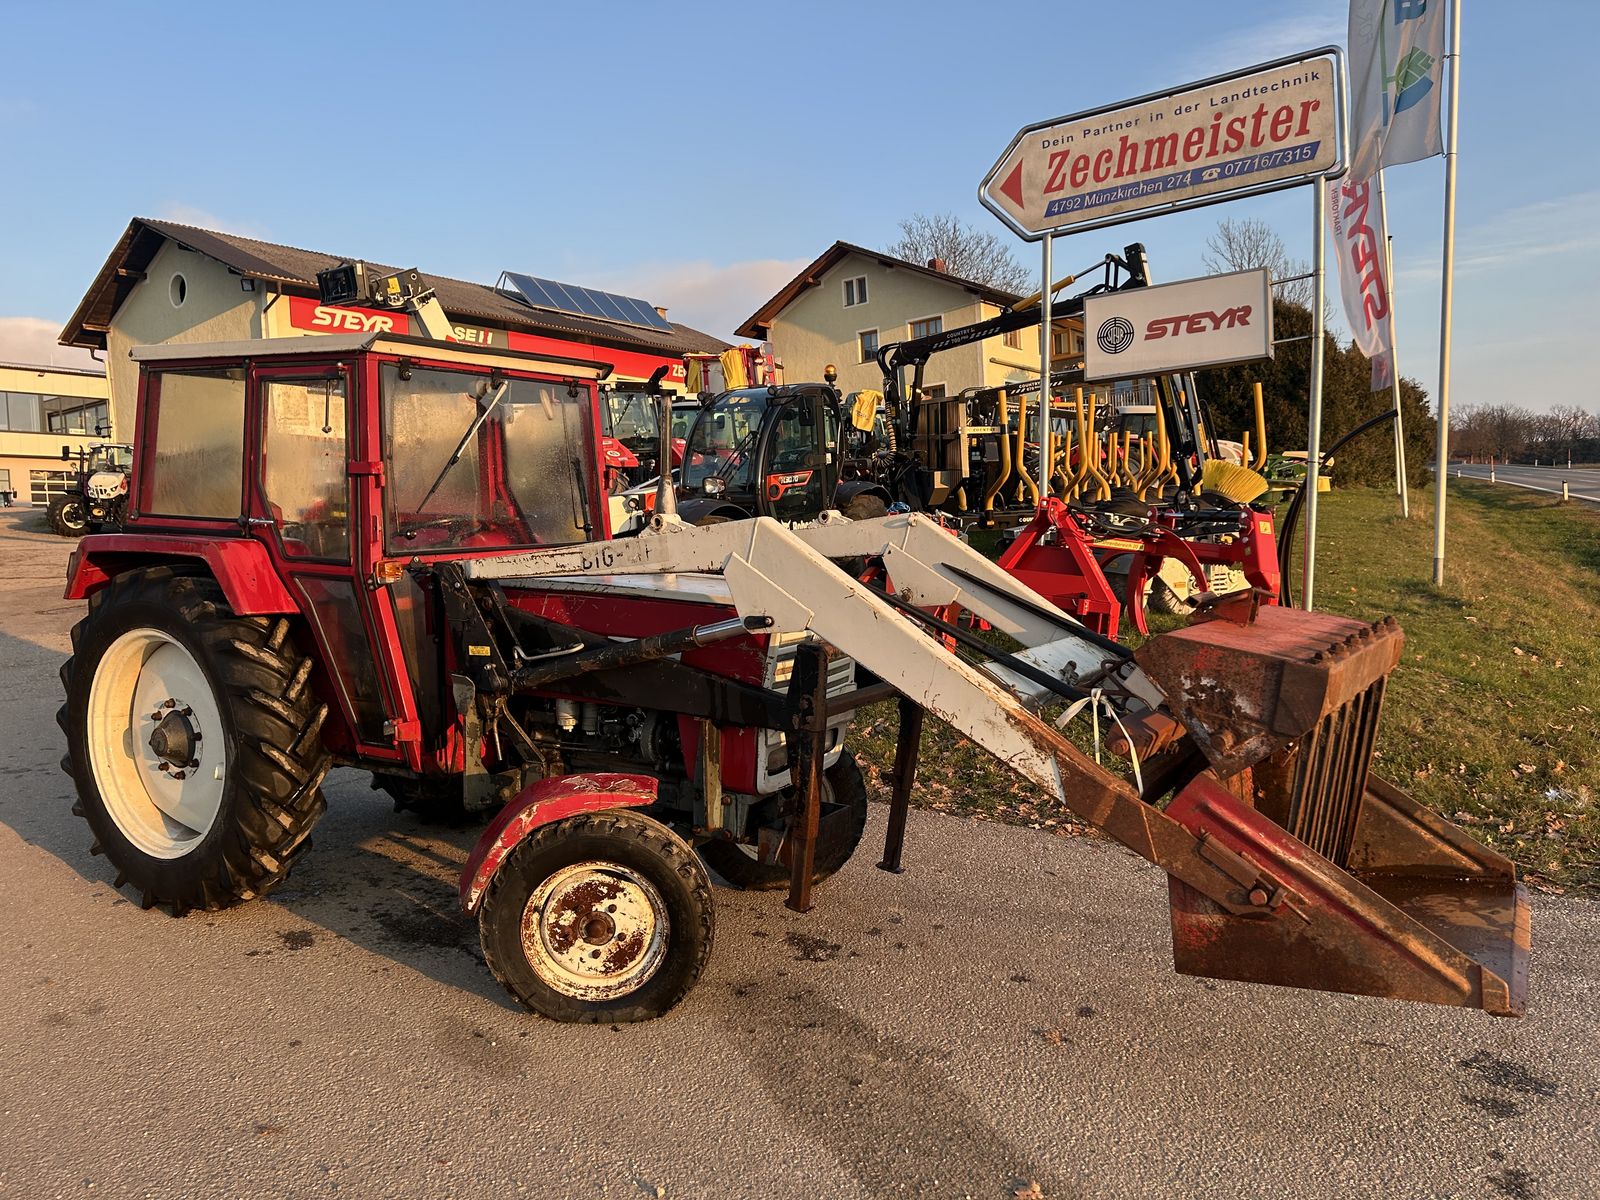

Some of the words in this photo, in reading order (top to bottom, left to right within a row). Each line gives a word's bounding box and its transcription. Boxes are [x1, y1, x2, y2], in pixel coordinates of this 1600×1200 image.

[1042, 134, 1074, 150] Dein
[1083, 116, 1141, 139] Partner
[1150, 111, 1164, 123] in
[1174, 101, 1201, 117] der
[1210, 70, 1321, 107] Landtechnik
[1043, 98, 1321, 195] Zechmeister
[1051, 197, 1081, 214] 4792
[1167, 171, 1192, 189] 274
[1224, 145, 1312, 177] 07716/7315
[312, 306, 394, 333] STEYR
[1144, 305, 1253, 341] STEYR
